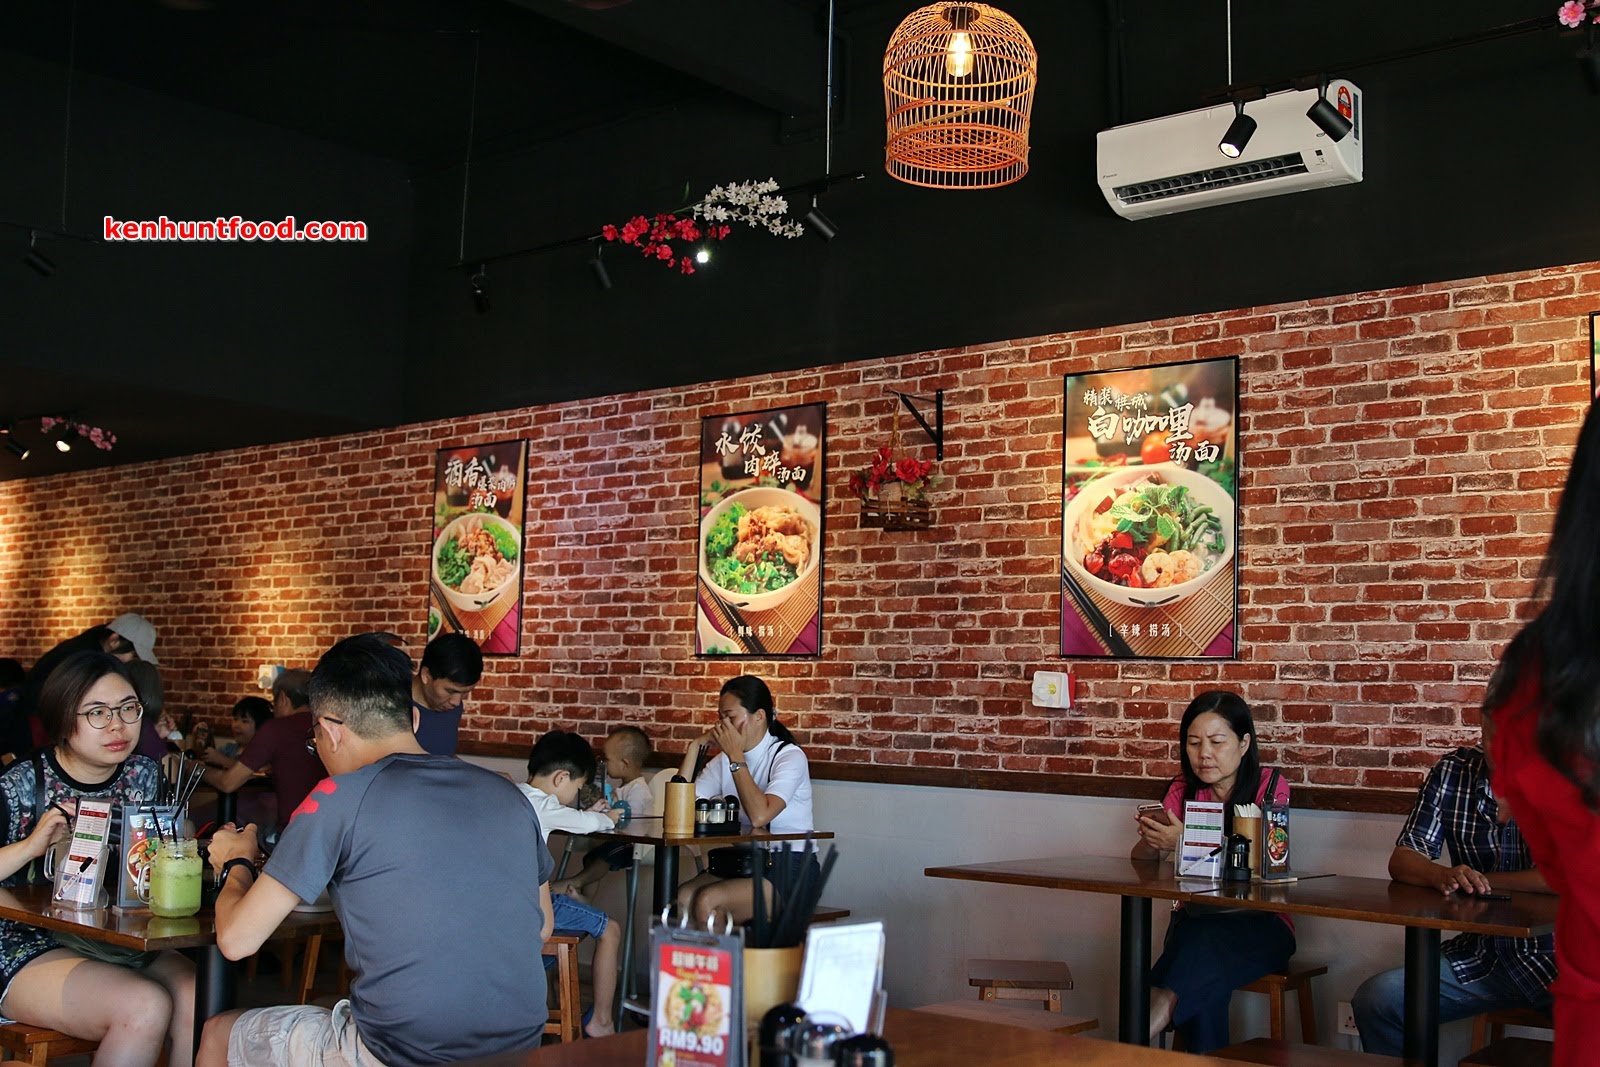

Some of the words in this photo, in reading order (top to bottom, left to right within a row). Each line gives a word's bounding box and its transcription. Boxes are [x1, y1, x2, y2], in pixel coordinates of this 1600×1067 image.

[1087, 402, 1194, 445] 白咖哩
[715, 423, 765, 456] 水饺
[1168, 440, 1219, 465] 汤面
[444, 456, 484, 487] 酒香
[659, 1027, 725, 1056] RM9.90
